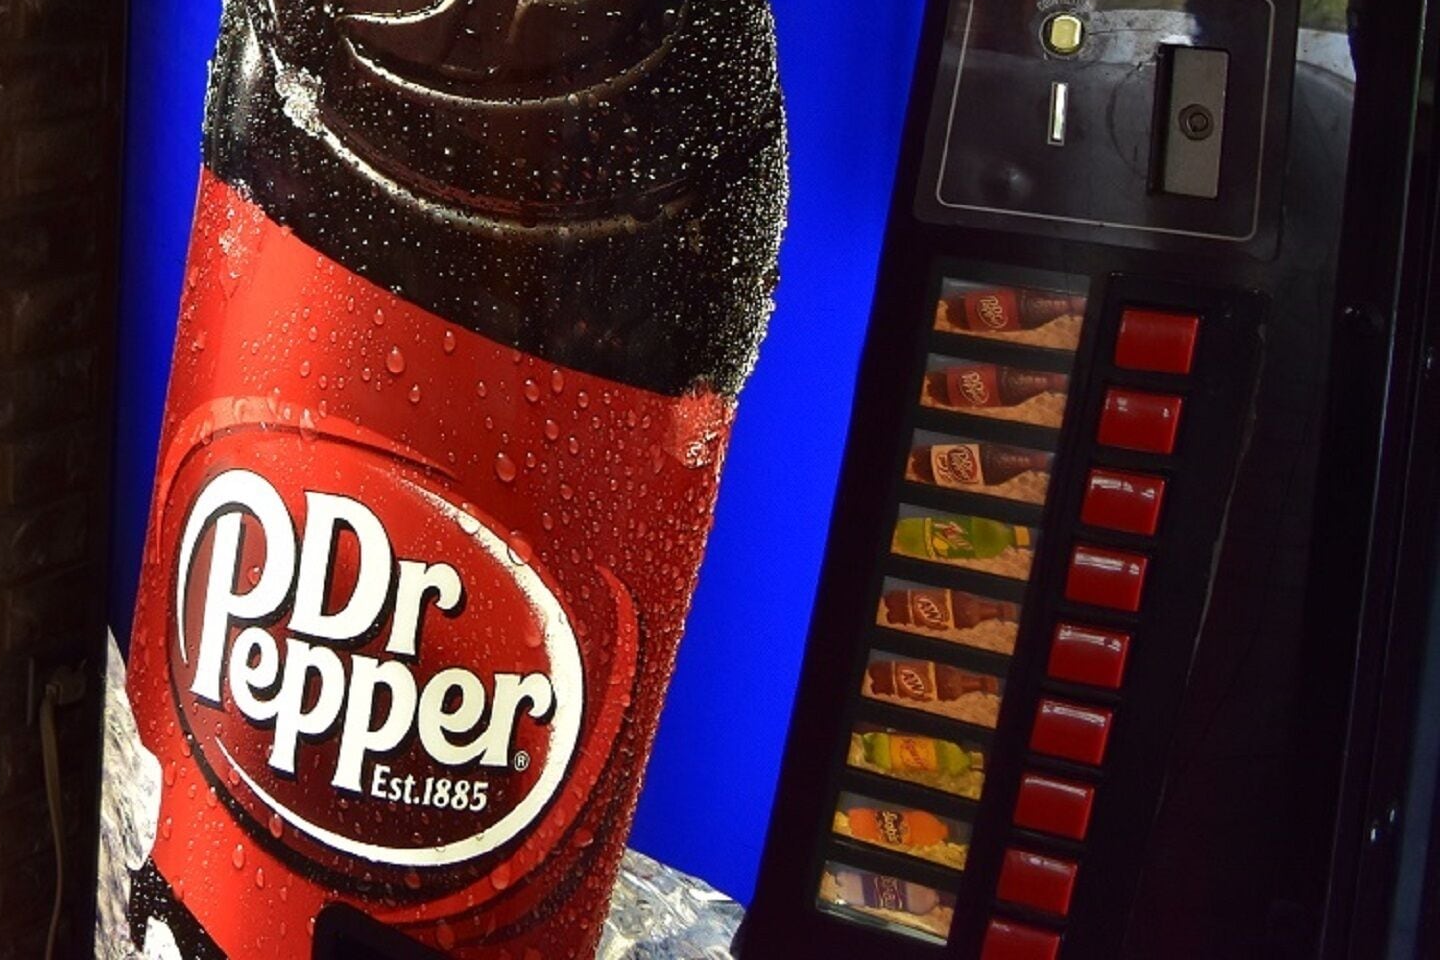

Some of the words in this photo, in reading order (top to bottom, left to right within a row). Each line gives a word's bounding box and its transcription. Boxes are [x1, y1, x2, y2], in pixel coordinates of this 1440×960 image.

[177, 468, 554, 792] Pepper
[288, 490, 462, 657] Dr
[371, 763, 490, 812] Est.1885
